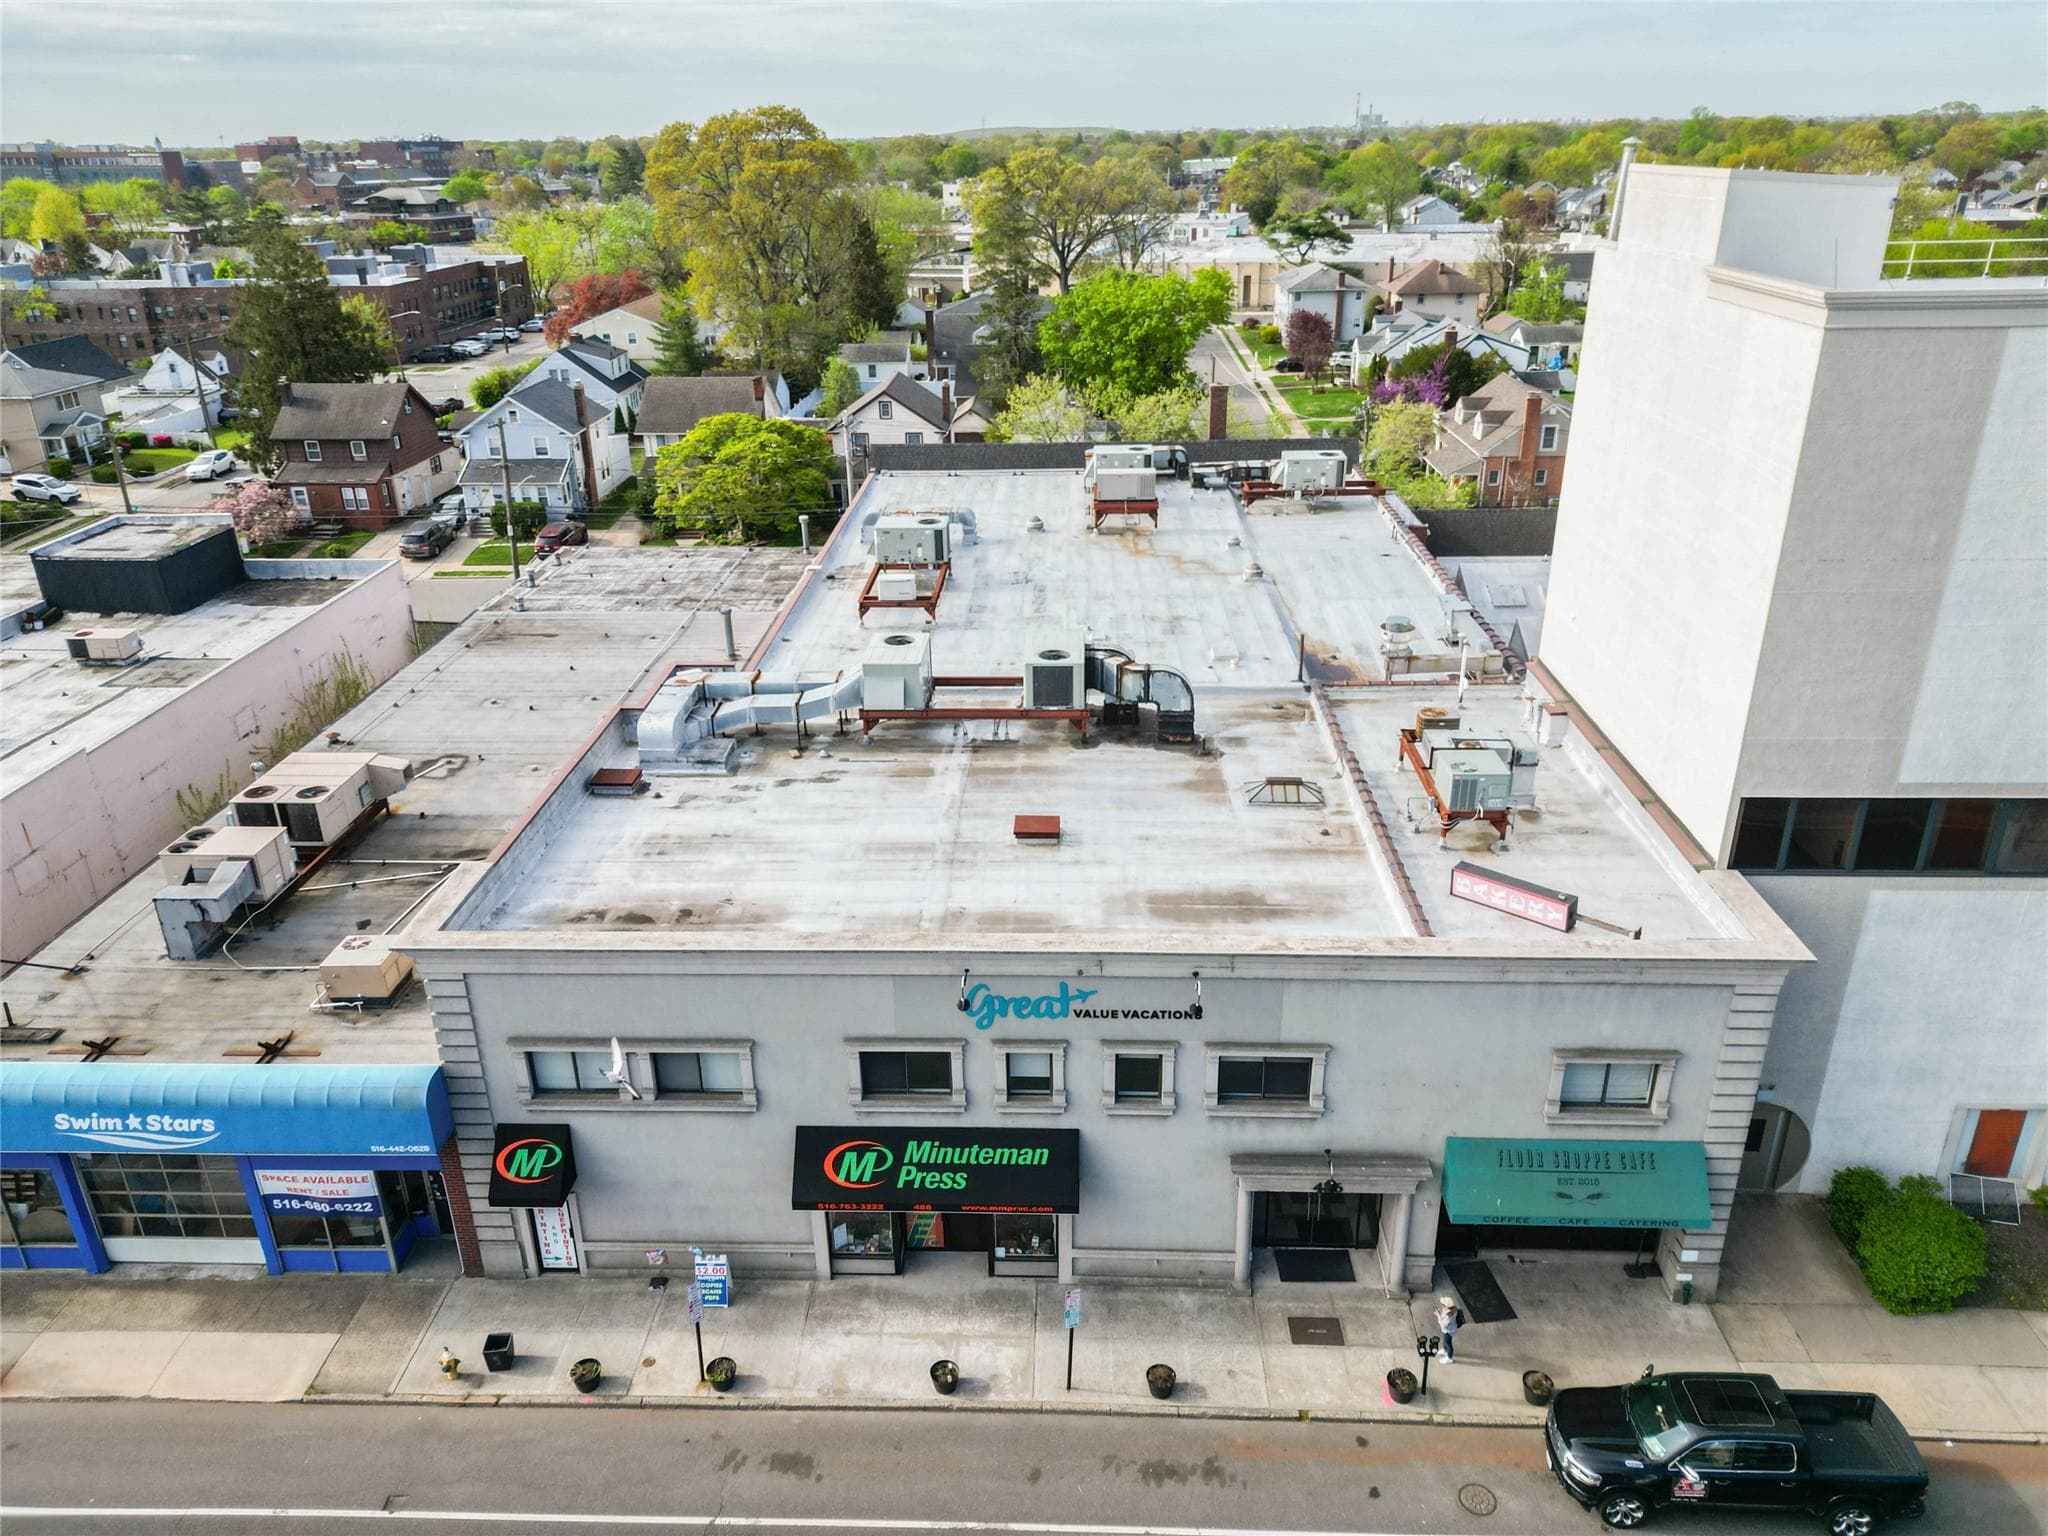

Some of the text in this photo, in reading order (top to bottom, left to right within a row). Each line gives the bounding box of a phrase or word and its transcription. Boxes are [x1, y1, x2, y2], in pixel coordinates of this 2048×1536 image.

[1073, 1009, 1118, 1019] VALUE
[54, 1113, 215, 1132] Swim Stars
[903, 1140, 1049, 1166] Minuteman
[1498, 1149, 1544, 1168] FLOUR
[1619, 1152, 1657, 1170] CAFE
[261, 1174, 369, 1185] SPACE AVAILABLE
[897, 1165, 967, 1190] Press
[286, 1187, 350, 1197] RENT SALE
[273, 1199, 374, 1213] 516-680-6222
[1483, 1216, 1680, 1227] COFFEE CAFE CATERING
[538, 1208, 552, 1255] RINTING
